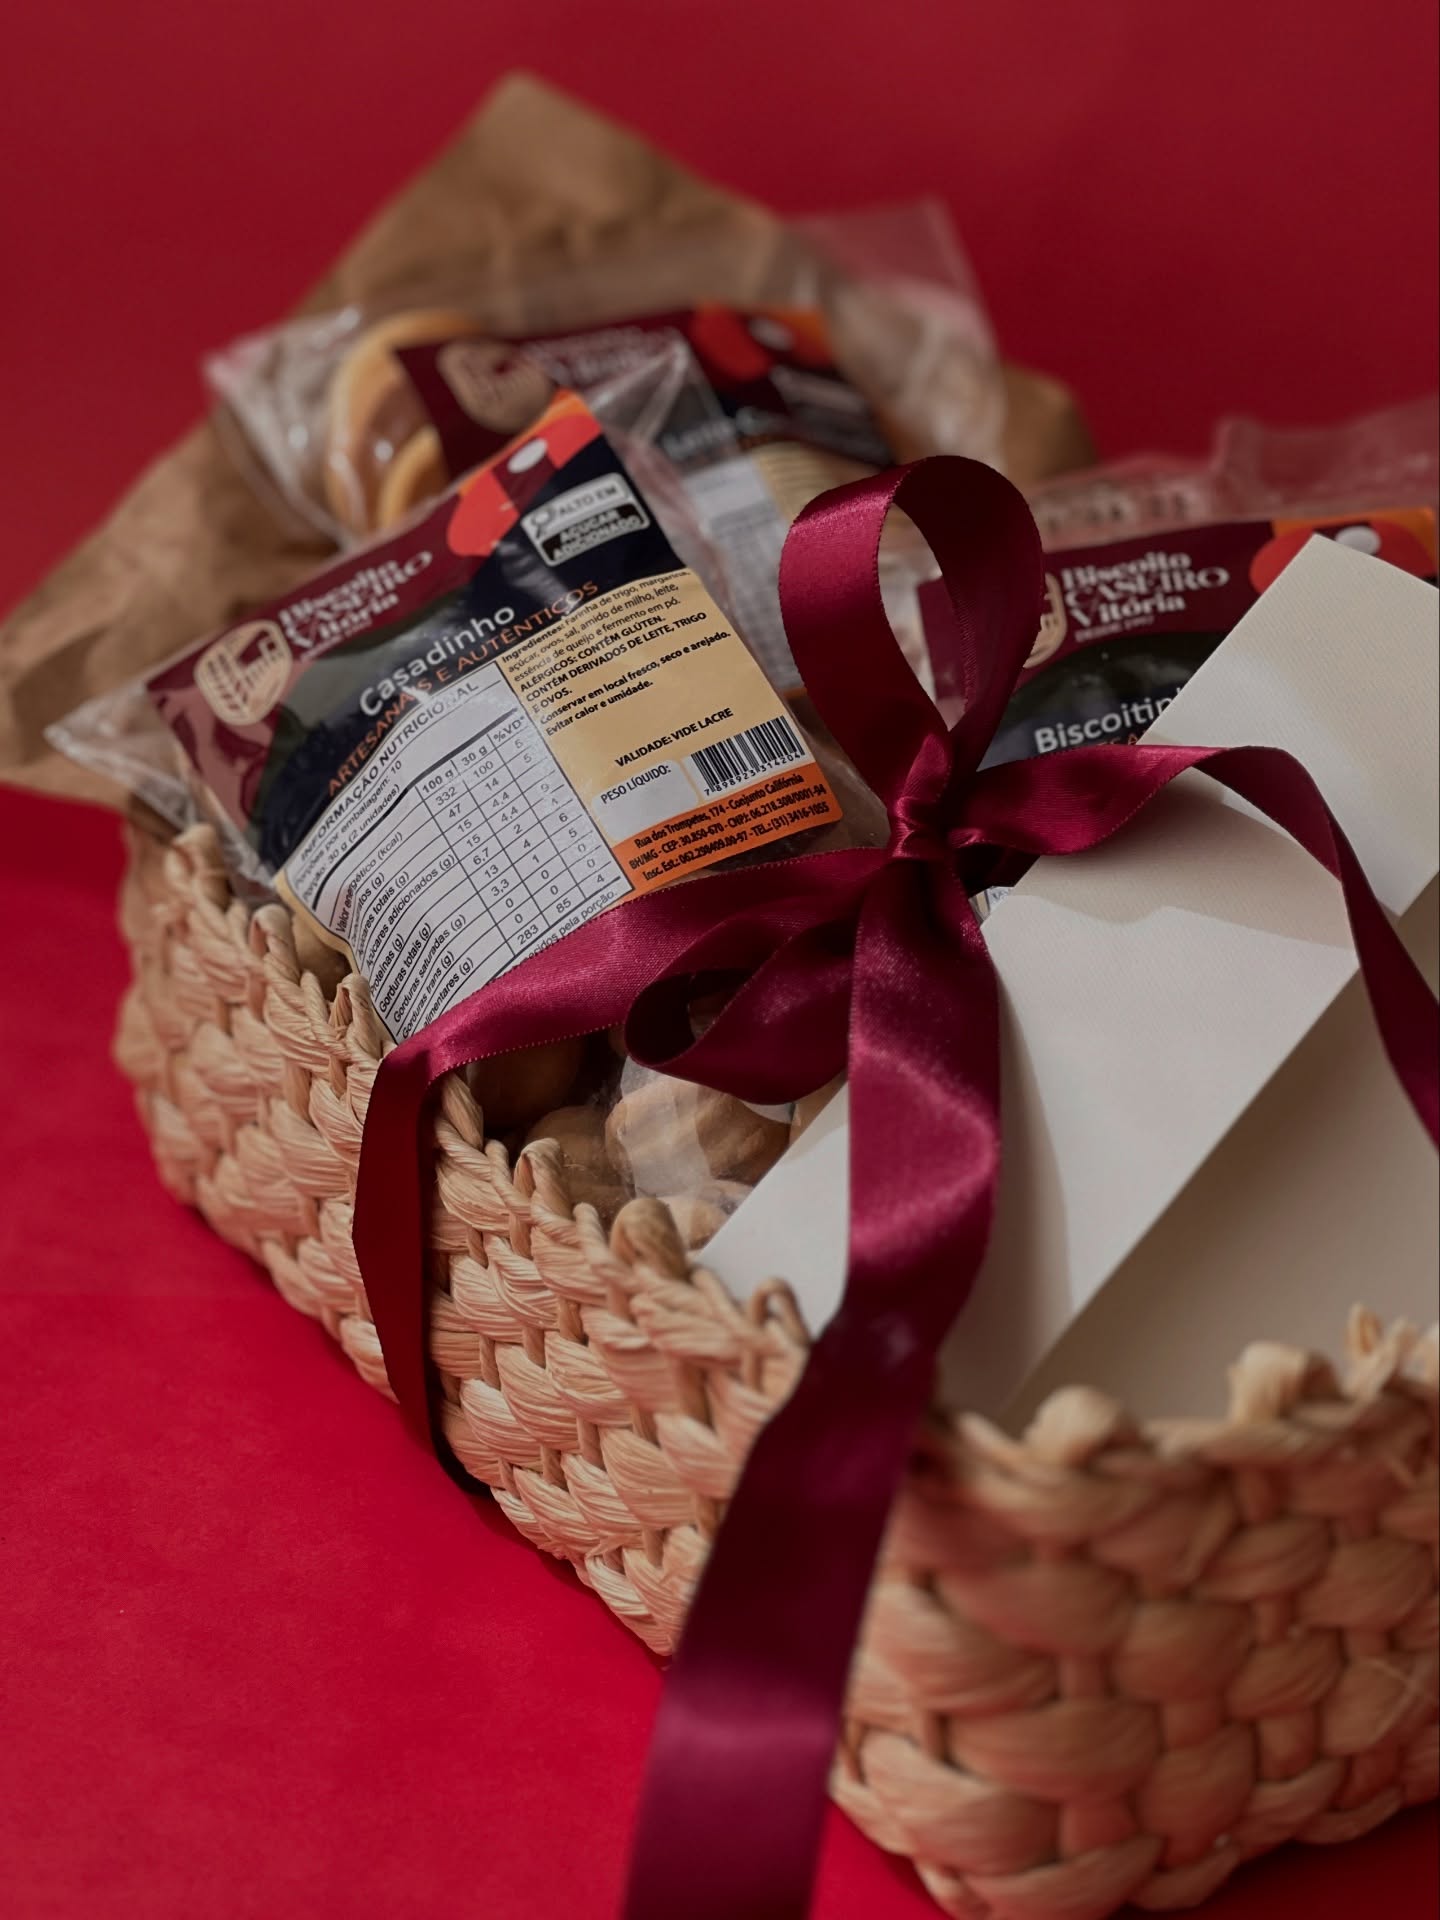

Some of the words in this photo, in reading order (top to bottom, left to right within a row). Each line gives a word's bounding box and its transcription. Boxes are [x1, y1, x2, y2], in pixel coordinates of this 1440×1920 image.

[553, 514, 641, 559] ADICIONADO
[560, 494, 594, 514] ALTO
[596, 486, 617, 499] EM
[1060, 552, 1192, 591] Biscoito
[1065, 566, 1230, 609] CASEIRO
[1068, 590, 1187, 627] Vitória
[359, 606, 515, 717] Casadinho
[436, 667, 452, 683] E
[457, 580, 600, 672] AUTÊNTICOS
[502, 622, 566, 664] Ingredientes:
[565, 601, 599, 625] Farinha
[599, 594, 613, 606] de
[613, 584, 639, 604] trigo,
[508, 648, 541, 673] açúcar,
[539, 637, 565, 653] ovos,
[563, 627, 580, 643] sal,
[581, 611, 609, 631] amido
[610, 603, 623, 615] de
[623, 589, 655, 610] milho,
[653, 582, 679, 600] leite,
[514, 656, 552, 682] essência
[552, 647, 565, 658] de
[565, 632, 595, 656] queijo
[596, 628, 603, 637] e
[602, 609, 647, 634] fermento
[647, 602, 664, 614] em
[664, 596, 681, 611] pó.
[519, 655, 578, 692] ALÉRGICOS:
[577, 631, 621, 660] CONTÉM
[620, 614, 666, 637] GLÚTEN.
[525, 674, 570, 702] CONTÉM
[569, 645, 628, 679] DERIVADOS
[627, 636, 643, 650] DE
[643, 623, 675, 642] LEITE,
[674, 612, 707, 630] TRIGO
[532, 704, 541, 713] E
[540, 686, 572, 709] OVOS.
[540, 695, 587, 725] Conservar
[587, 688, 604, 701] em
[603, 674, 629, 693] local
[627, 661, 661, 681] fresco,
[660, 650, 682, 664] seco
[682, 646, 691, 654] e
[690, 630, 731, 651] arejado.
[546, 715, 575, 736] Evitar
[574, 703, 600, 720] calor
[600, 699, 608, 708] e
[607, 679, 653, 704] umidade.
[615, 735, 673, 767] VALIDADE:
[670, 722, 699, 741] VIDE
[699, 707, 734, 729] LACRE
[1034, 687, 1182, 754] Biscoitin
[301, 764, 380, 862] INFORMAÇÃO
[380, 682, 480, 766] NUTRICIOAL
[325, 832, 341, 853] por
[341, 775, 391, 834] embalagem:
[390, 760, 402, 775] 10
[422, 775, 444, 795] 100
[444, 769, 455, 780] g
[461, 752, 477, 767] 30
[478, 745, 488, 757] g
[600, 785, 627, 804] PESO
[628, 764, 672, 791] LÍQUIDO:
[327, 851, 341, 868] 30
[340, 841, 349, 853] g
[359, 784, 400, 839] unidades)
[335, 909, 352, 933] Valor
[345, 858, 377, 909] energético
[377, 831, 403, 860] (kcal)
[435, 786, 457, 807] 332
[472, 760, 494, 779] 100
[371, 872, 386, 890] (g)
[448, 803, 462, 819] 47
[485, 777, 500, 792] 14
[523, 753, 532, 764] 5
[388, 868, 439, 924] adicionados
[439, 854, 456, 871] (g)
[466, 834, 481, 849] 15
[540, 783, 550, 794] 9
[629, 850, 660, 870] BH/MG
[661, 840, 681, 855] CEP:
[634, 836, 653, 849] Rua
[652, 828, 668, 841] dos
[709, 804, 726, 819] 174
[728, 788, 766, 812] Conjunto
[771, 813, 790, 831] (31)
[374, 887, 395, 915] totais
[394, 871, 410, 888] (g)
[458, 819, 473, 834] 15
[391, 933, 405, 952] (g)
[513, 823, 523, 835] 2
[379, 966, 407, 1013] Gorduras
[403, 940, 422, 968] totais
[418, 922, 432, 941] (g)
[484, 864, 500, 880] 13
[522, 838, 532, 850] 4
[558, 812, 569, 823] 6
[393, 977, 421, 1023] Gorduras
[418, 928, 451, 978] saturadas
[451, 914, 467, 932] (g)
[490, 878, 510, 897] 3,3
[531, 854, 540, 865] 1
[568, 827, 578, 839] 5
[402, 994, 428, 1040] Gorduras
[426, 968, 443, 994] trans
[440, 951, 456, 969] (g)
[505, 897, 514, 909] 0
[540, 869, 550, 881] 0
[577, 842, 587, 853] 0
[459, 957, 475, 976] (g)
[514, 913, 524, 924] 0
[549, 884, 559, 896] 0
[586, 858, 596, 869] 0
[517, 924, 539, 946] 283
[555, 898, 573, 914] 85
[596, 874, 605, 885] 4
[559, 916, 581, 938] pela
[581, 891, 618, 919] porção.
